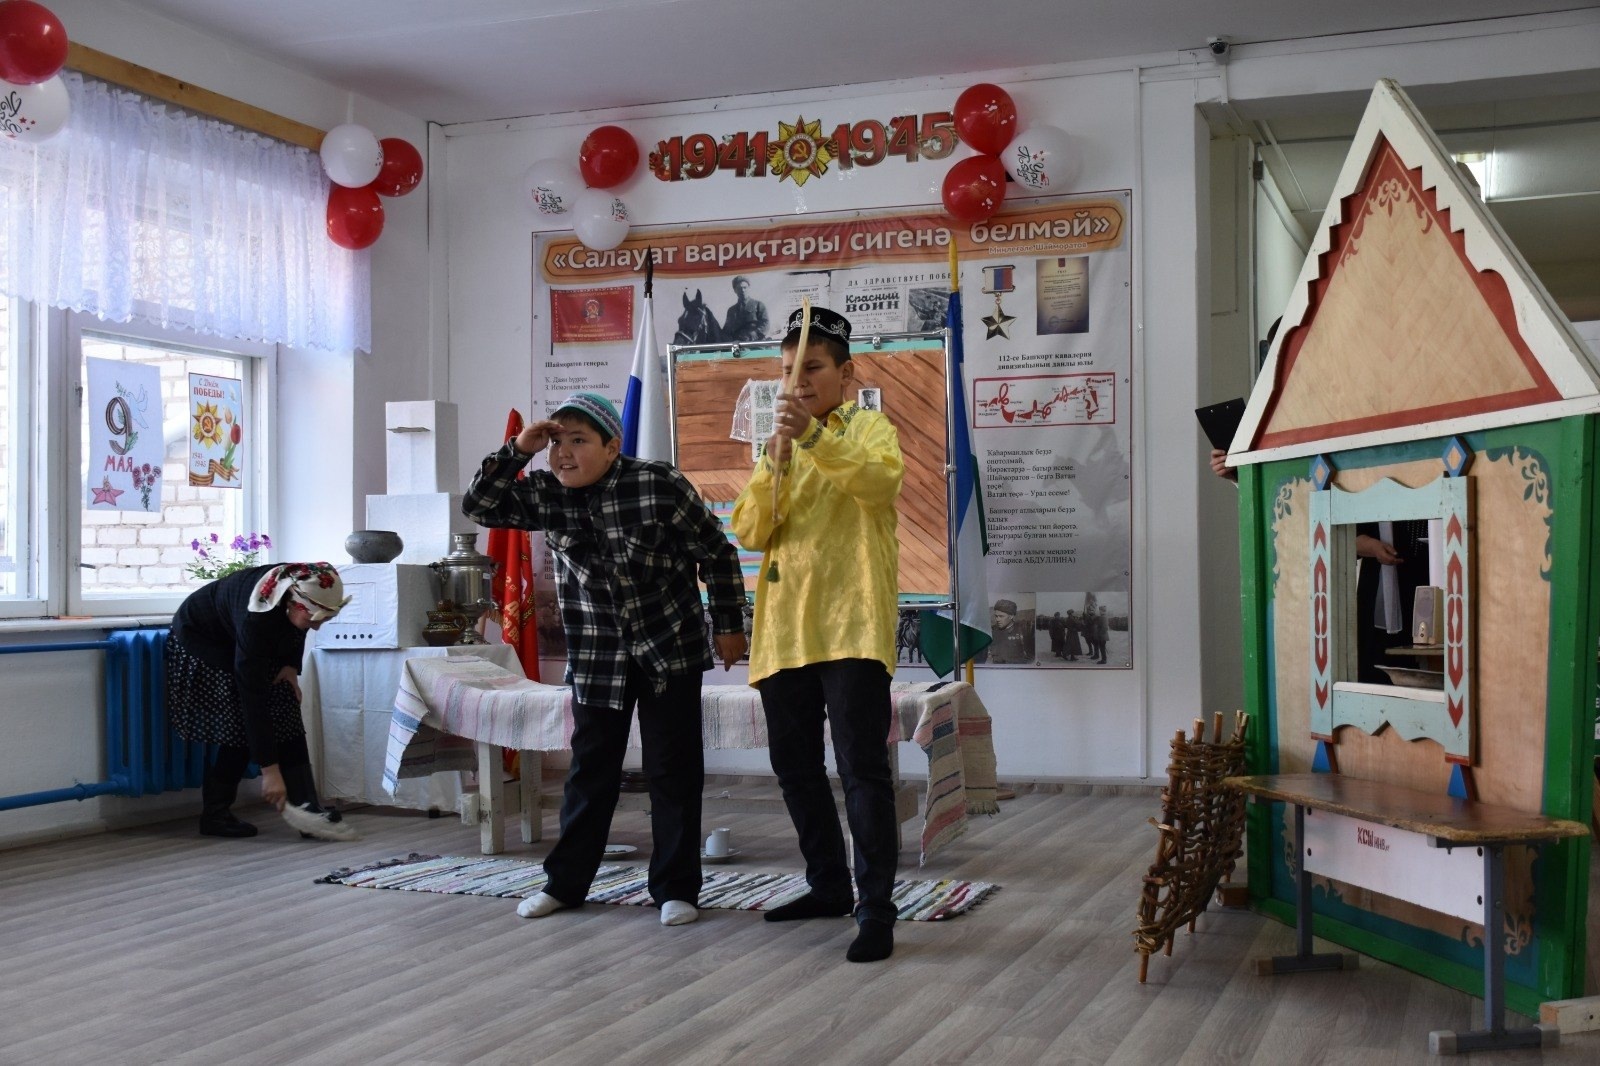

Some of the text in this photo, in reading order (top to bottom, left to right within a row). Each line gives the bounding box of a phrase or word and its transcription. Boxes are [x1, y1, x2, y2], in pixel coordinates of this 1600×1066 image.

[664, 130, 769, 182] 1941
[831, 112, 956, 171] 1945
[553, 211, 1111, 270] «Салауат вариҫтары сигенә белмәй»
[864, 274, 925, 285] ЗДРАВСТВУЕТ
[846, 291, 900, 304] Красный
[193, 386, 225, 399] ПОБЕДЫ!
[104, 455, 133, 473] МАЯ
[1032, 465, 1052, 473] батыр
[986, 474, 1030, 482] Шайморатов
[1055, 472, 1076, 480] Ватан
[1030, 490, 1047, 498] Урал
[1024, 556, 1076, 565] АБДУЛЛИНА)
